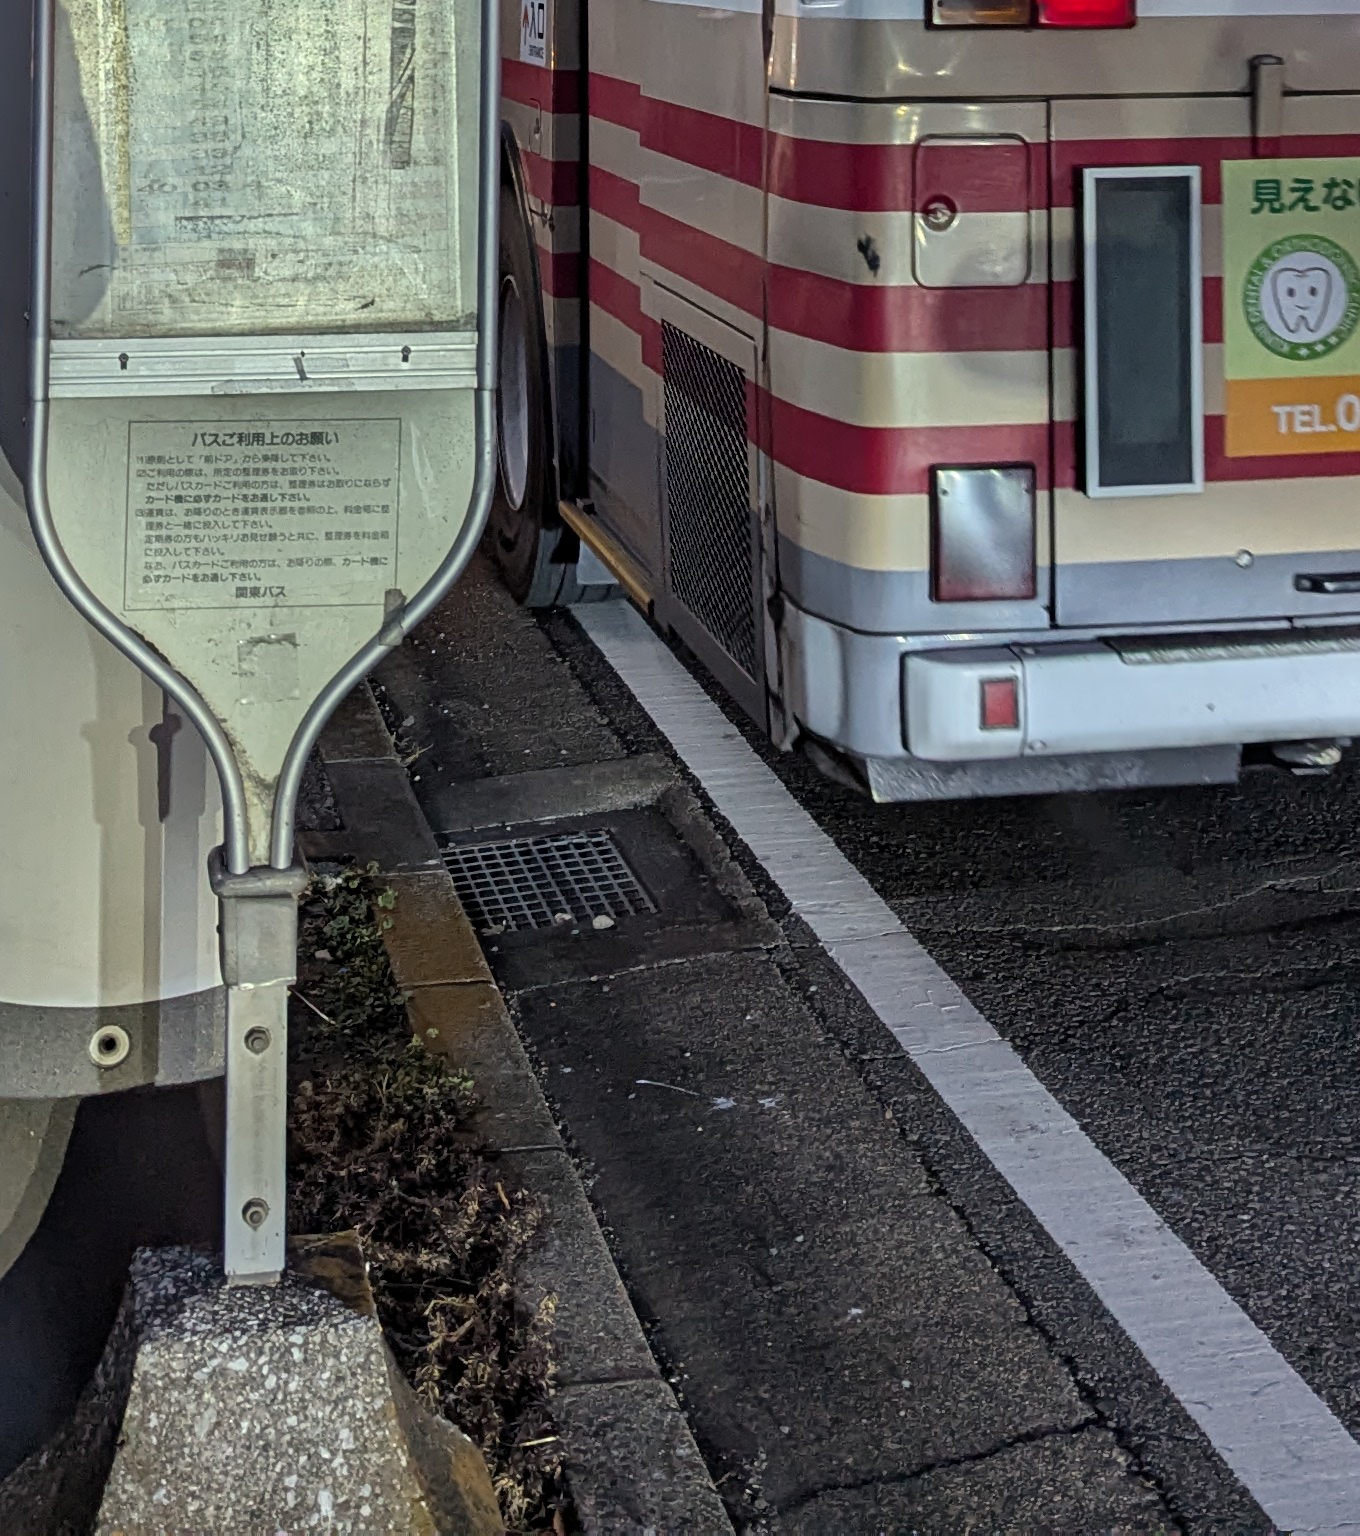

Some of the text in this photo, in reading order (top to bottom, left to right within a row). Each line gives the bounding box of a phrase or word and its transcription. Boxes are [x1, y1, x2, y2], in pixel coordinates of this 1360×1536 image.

[191, 431, 340, 447] バスご利用上のお願い
[235, 585, 287, 599] 関東バス
